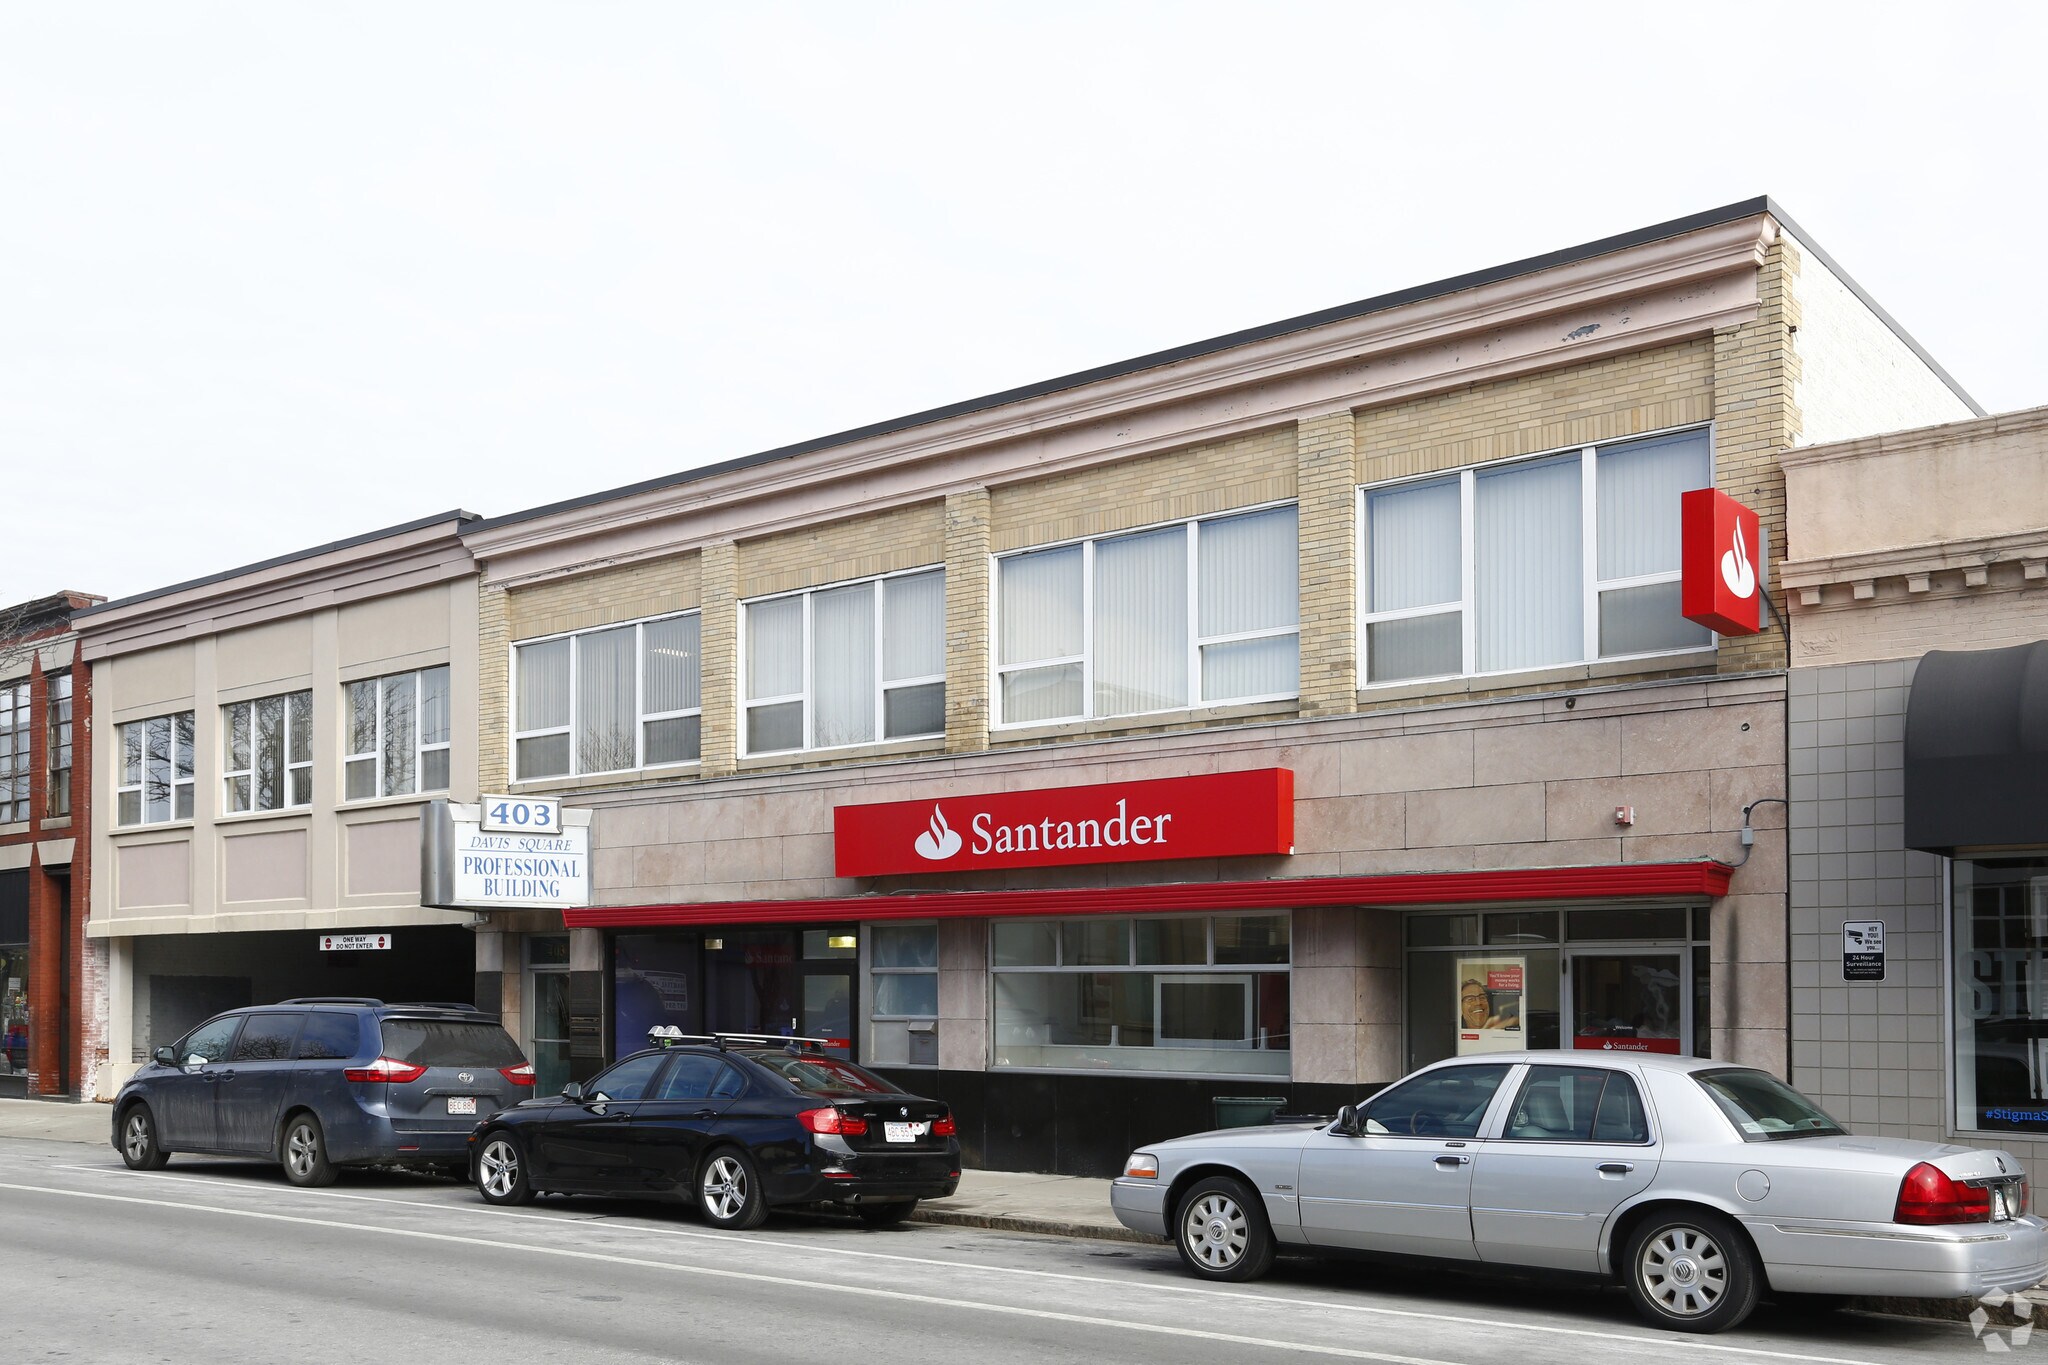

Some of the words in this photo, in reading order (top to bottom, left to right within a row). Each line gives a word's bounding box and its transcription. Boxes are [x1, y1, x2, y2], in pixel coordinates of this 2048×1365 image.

[490, 803, 551, 826] 403
[971, 798, 1172, 855] Santander
[470, 836, 511, 849] DAVIS
[518, 838, 572, 853] SQUARE
[463, 856, 581, 878] PROFESSIONAL
[484, 878, 560, 898] BUILDING
[1613, 1042, 1648, 1051] Santander
